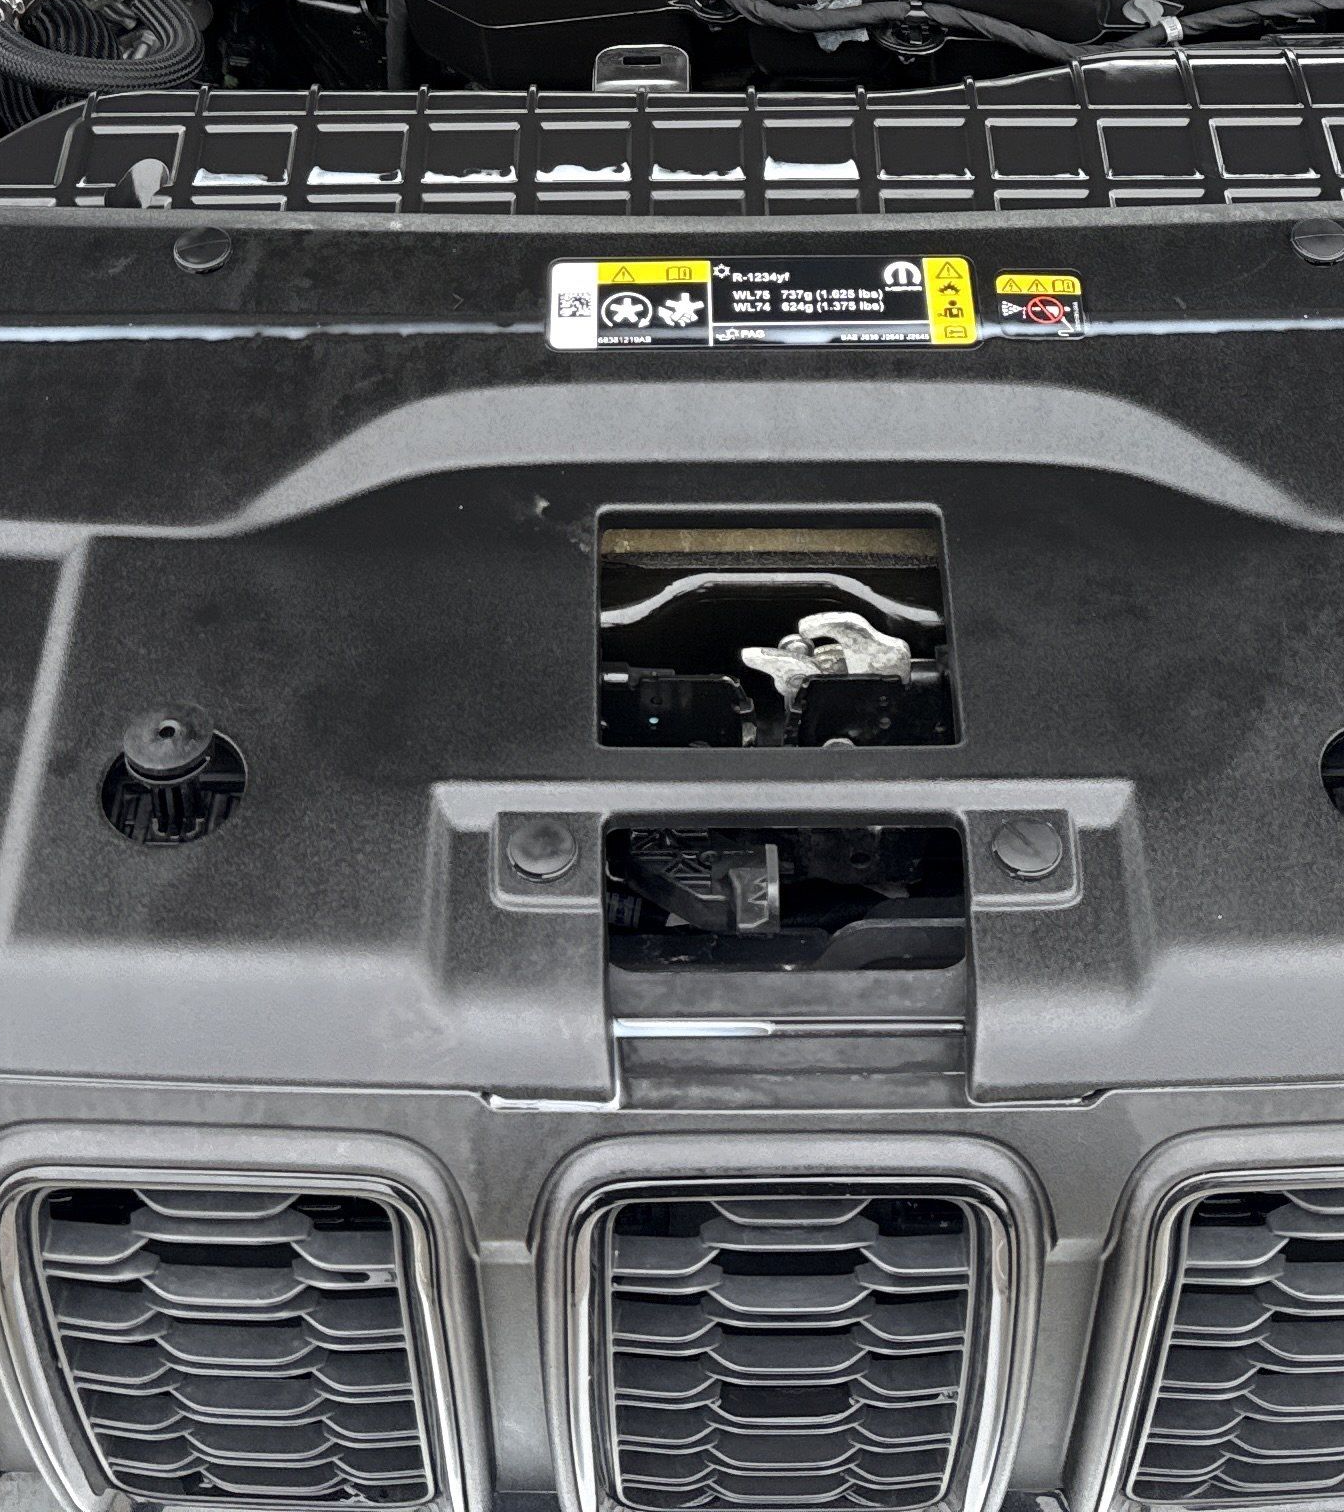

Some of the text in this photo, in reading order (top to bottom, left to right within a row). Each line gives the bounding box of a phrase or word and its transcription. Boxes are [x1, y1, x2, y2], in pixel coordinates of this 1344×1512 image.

[732, 272, 790, 284] R-1234yf
[732, 290, 771, 300] WL75
[781, 289, 813, 301] 737g
[815, 288, 855, 301] (1.625
[858, 288, 884, 300] lbs)
[733, 301, 885, 313] WL74 624g (1.375 lbs)
[740, 329, 766, 338] PAG
